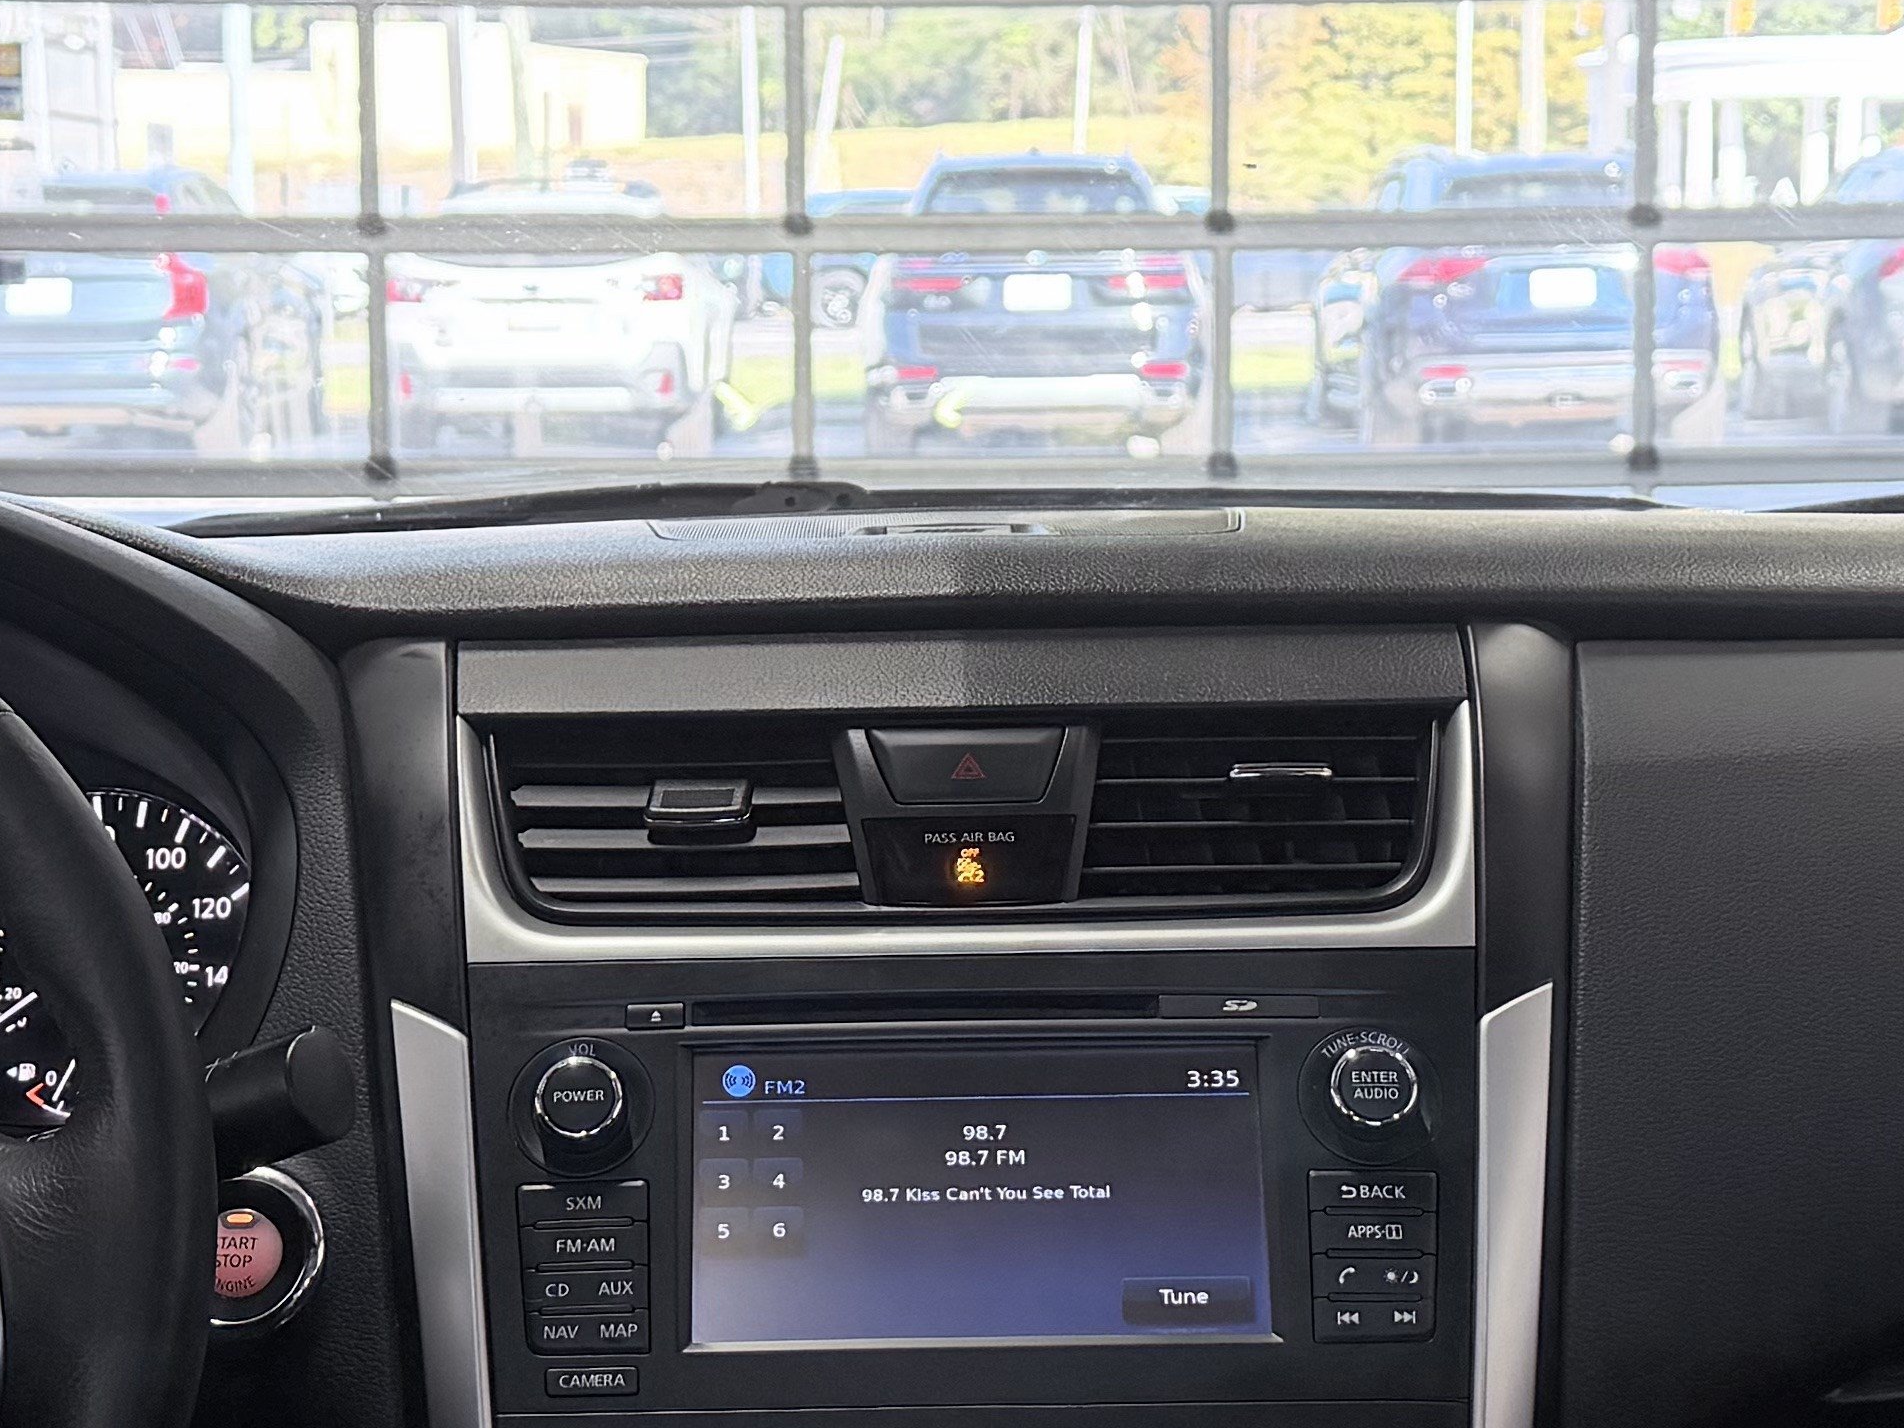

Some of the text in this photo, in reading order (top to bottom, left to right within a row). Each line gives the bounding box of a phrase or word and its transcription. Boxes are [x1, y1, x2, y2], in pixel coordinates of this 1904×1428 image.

[924, 831, 1015, 845] PASS AIR BAG
[145, 847, 187, 870] 100
[192, 896, 232, 919] 120
[4, 987, 23, 1001] 20
[1222, 999, 1258, 1012] SD
[567, 1043, 597, 1058] VOL
[1186, 1069, 1241, 1088] 3:35
[1351, 1070, 1399, 1083] ENTER
[764, 1079, 806, 1095] FM2
[1353, 1087, 1399, 1100] AUDIO
[553, 1089, 605, 1103] POWER
[718, 1124, 785, 1142] 1 2
[962, 1124, 1008, 1141] 98.7
[943, 1149, 1027, 1167] 98.7 FM
[718, 1172, 786, 1190] 3 4
[861, 1183, 1111, 1203] 98.7 Kiss Can't You See Total
[1359, 1185, 1406, 1199] BACK
[565, 1195, 603, 1211] SXM
[717, 1222, 786, 1240] 5 6
[217, 1236, 259, 1251] TART
[215, 1274, 257, 1293] NGINE
[544, 1283, 570, 1298] CD
[598, 1280, 635, 1296] AUX
[1158, 1288, 1209, 1305] Tune
[543, 1324, 579, 1340] NAV
[600, 1323, 638, 1339] MAP
[558, 1373, 626, 1388] CAMERA
